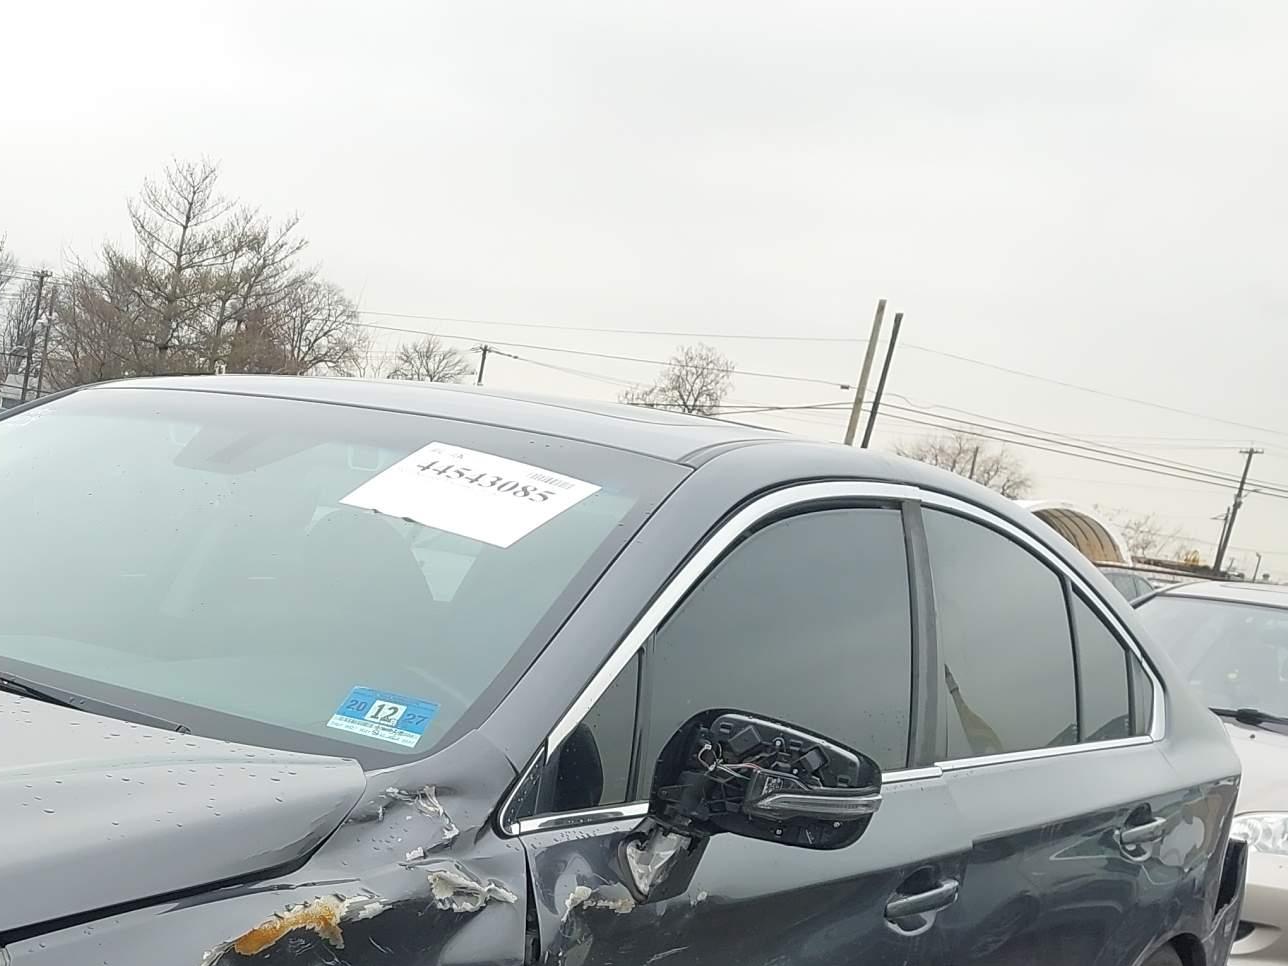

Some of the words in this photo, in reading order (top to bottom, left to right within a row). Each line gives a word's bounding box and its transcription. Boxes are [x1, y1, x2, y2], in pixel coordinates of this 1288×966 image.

[416, 460, 556, 502] 44543085
[346, 699, 367, 712] 20
[370, 703, 399, 722] 12
[404, 713, 428, 725] 27
